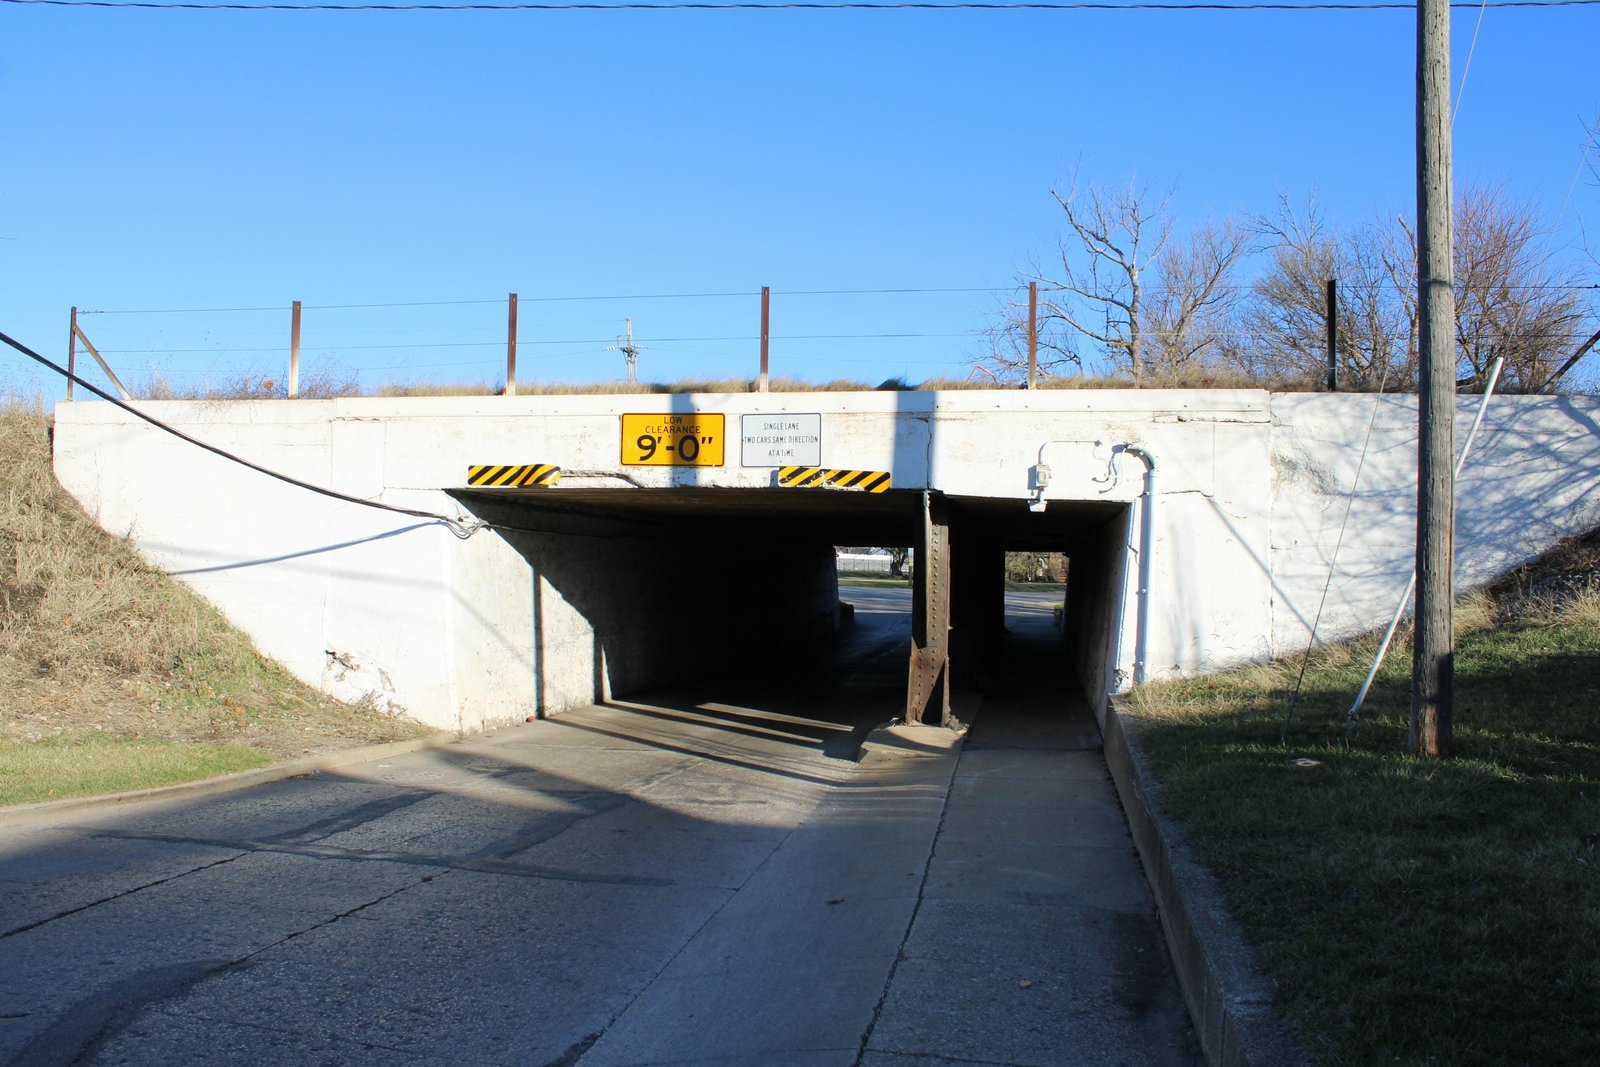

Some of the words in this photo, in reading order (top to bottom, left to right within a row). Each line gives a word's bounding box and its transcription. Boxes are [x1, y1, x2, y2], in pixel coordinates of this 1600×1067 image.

[664, 416, 683, 424] LOW
[645, 425, 701, 434] CLEARANCE
[763, 422, 784, 430] SINGLE
[785, 422, 799, 430] LANE
[744, 436, 756, 444] TWO
[788, 435, 818, 443] DIRECTION
[768, 449, 775, 457] AT
[775, 449, 780, 457] A
